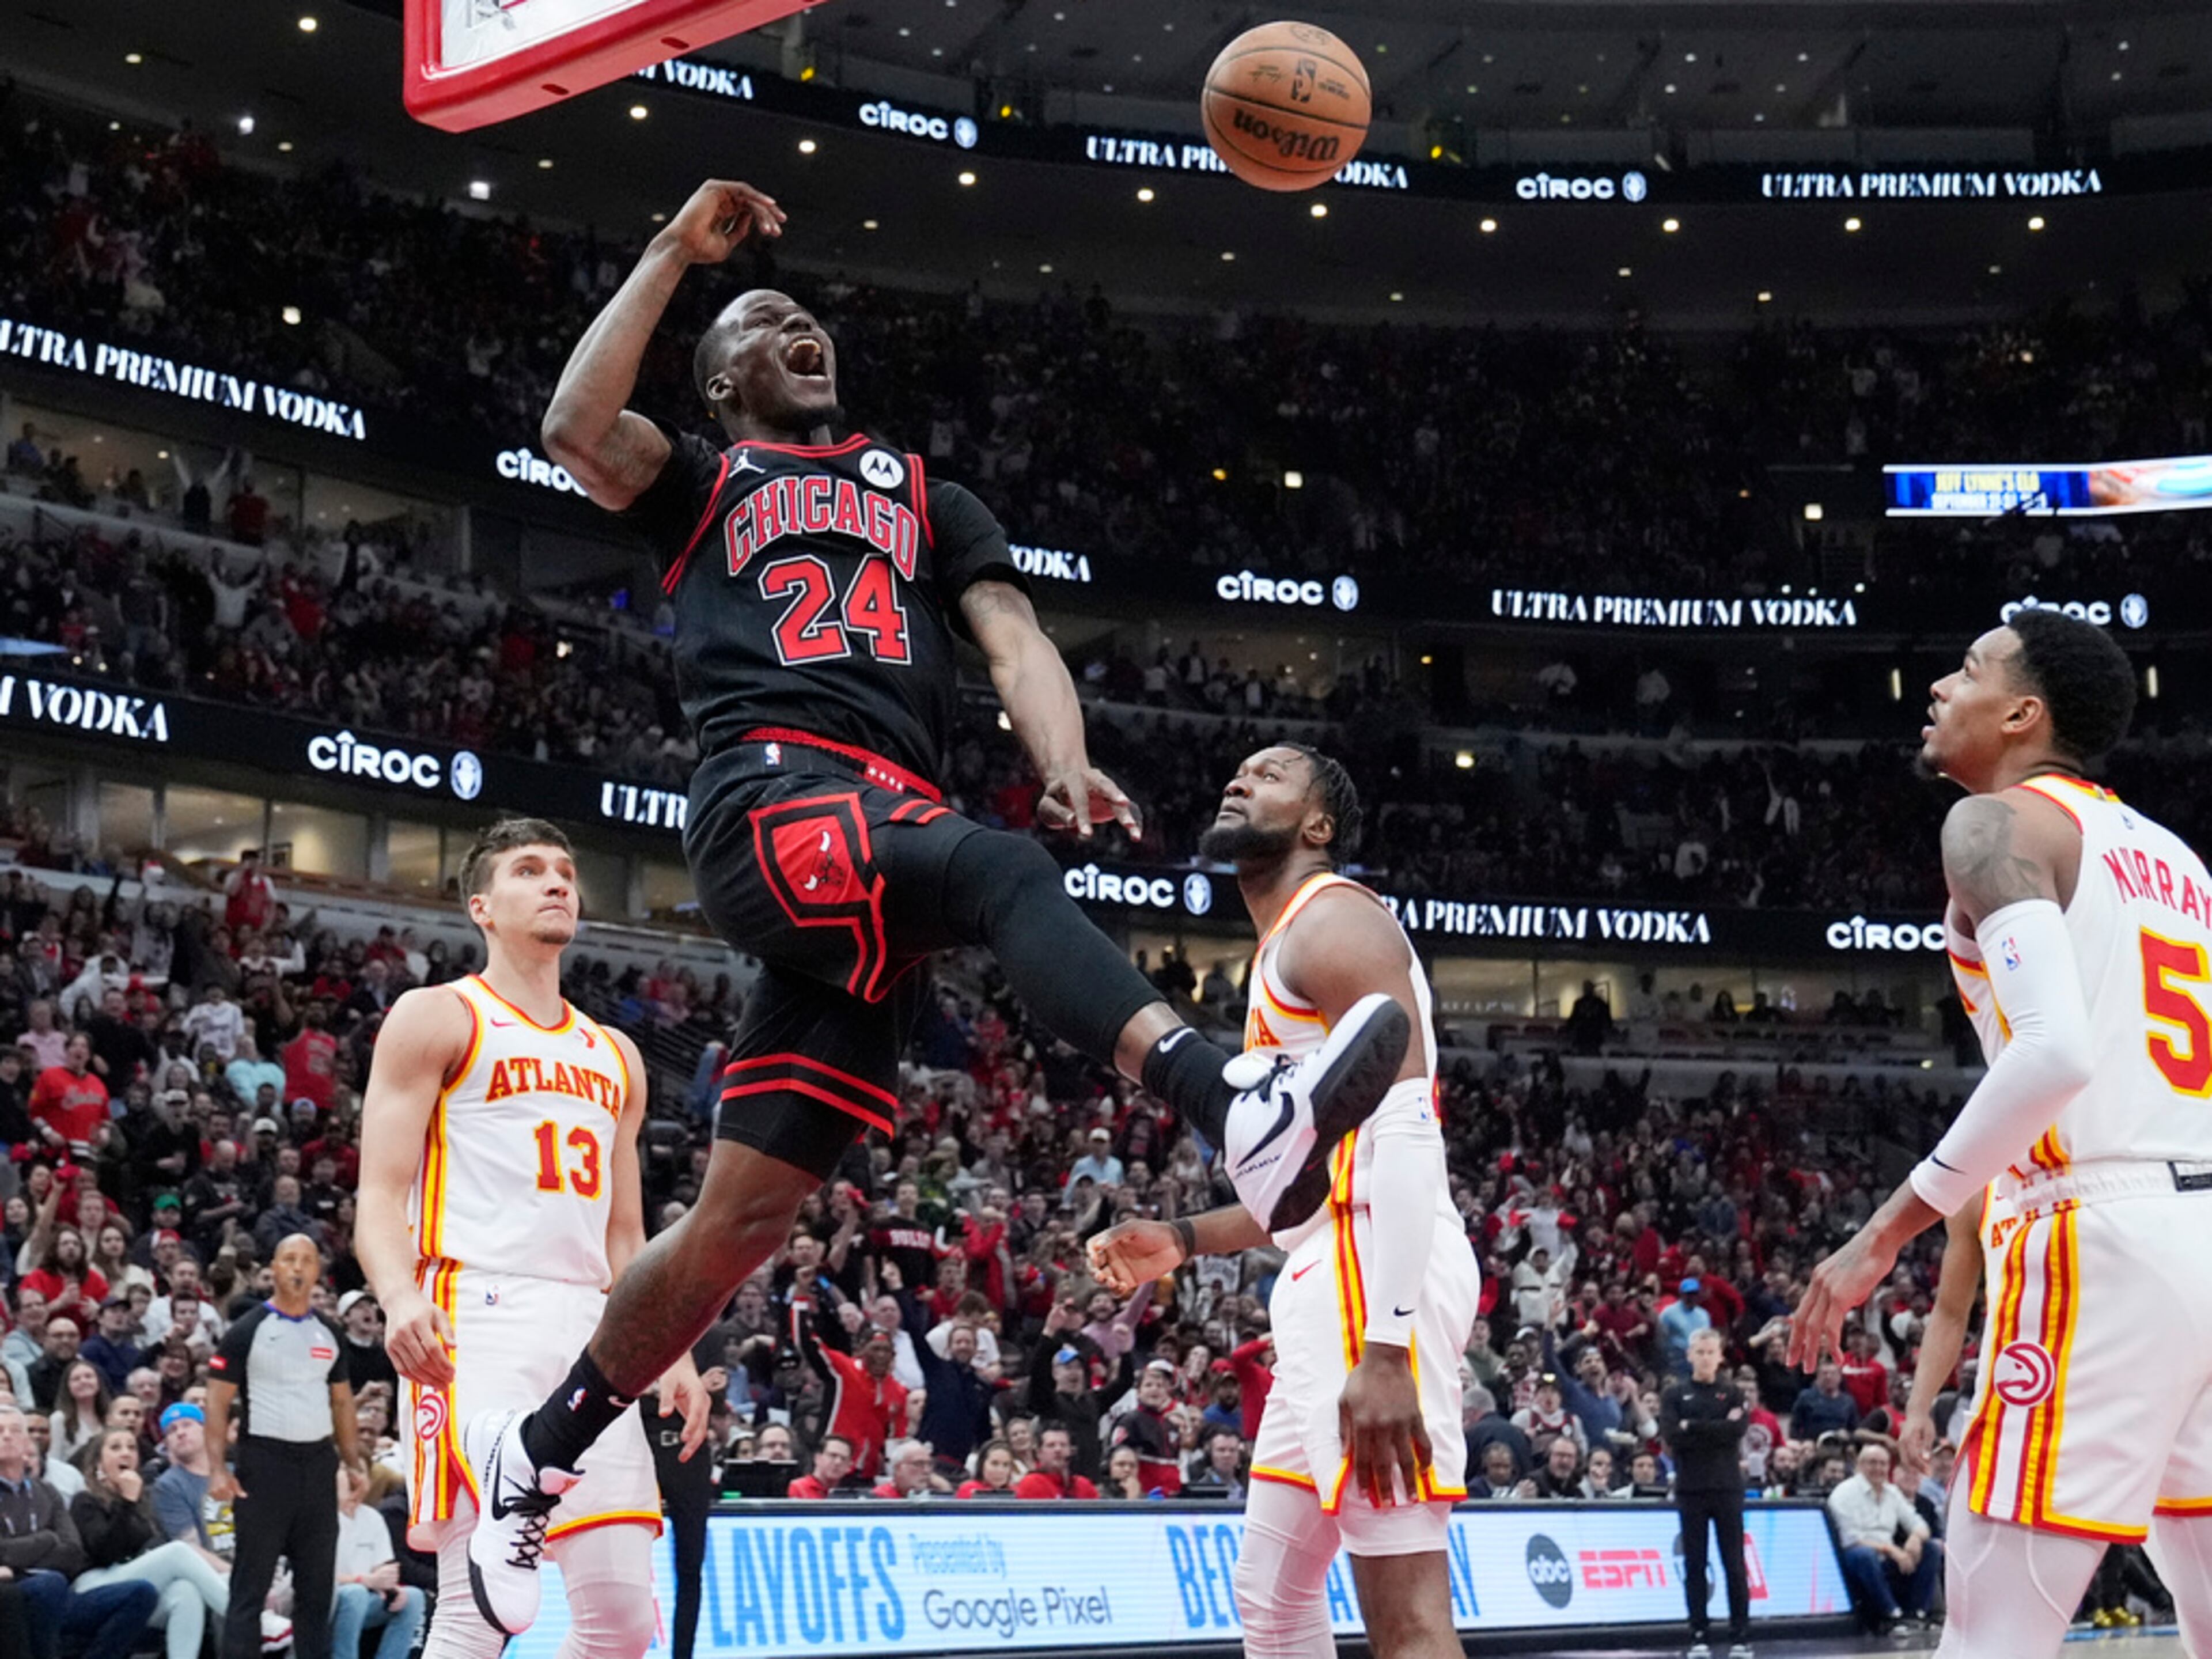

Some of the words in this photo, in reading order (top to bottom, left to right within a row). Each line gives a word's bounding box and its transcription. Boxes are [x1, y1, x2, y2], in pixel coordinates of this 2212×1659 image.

[662, 59, 753, 100] VODKA
[1233, 108, 1340, 161] Wilson
[1086, 136, 1176, 168] ULTRA
[1334, 161, 1408, 190] ODKA
[1762, 173, 1854, 198] ULTRA
[1860, 172, 1997, 198] PREMIUM
[2003, 170, 2102, 198] VODKA
[0, 319, 87, 372] LTRA
[94, 343, 256, 412] PREMIUM
[263, 385, 366, 440] VODKA
[724, 476, 919, 581] CHICAGO
[1009, 544, 1092, 582] ODKA
[758, 553, 912, 666] 24
[1491, 589, 1587, 622] ULTRA
[1593, 595, 1743, 627] PREMIUM
[1750, 599, 1857, 626] VODKA
[26, 679, 169, 743] VODKA
[600, 782, 689, 830] ULTR
[1425, 899, 1588, 940] PREMIUM
[1596, 909, 1711, 944] VODKA
[2139, 925, 2212, 1099] 5
[533, 1120, 601, 1201] 13
[703, 1526, 906, 1647] LAYOFFS
[1528, 1553, 1569, 1584] abc
[1578, 1548, 1667, 1589] ESPN
[923, 1587, 1038, 1639] Google
[1041, 1585, 1113, 1626] Pixel
